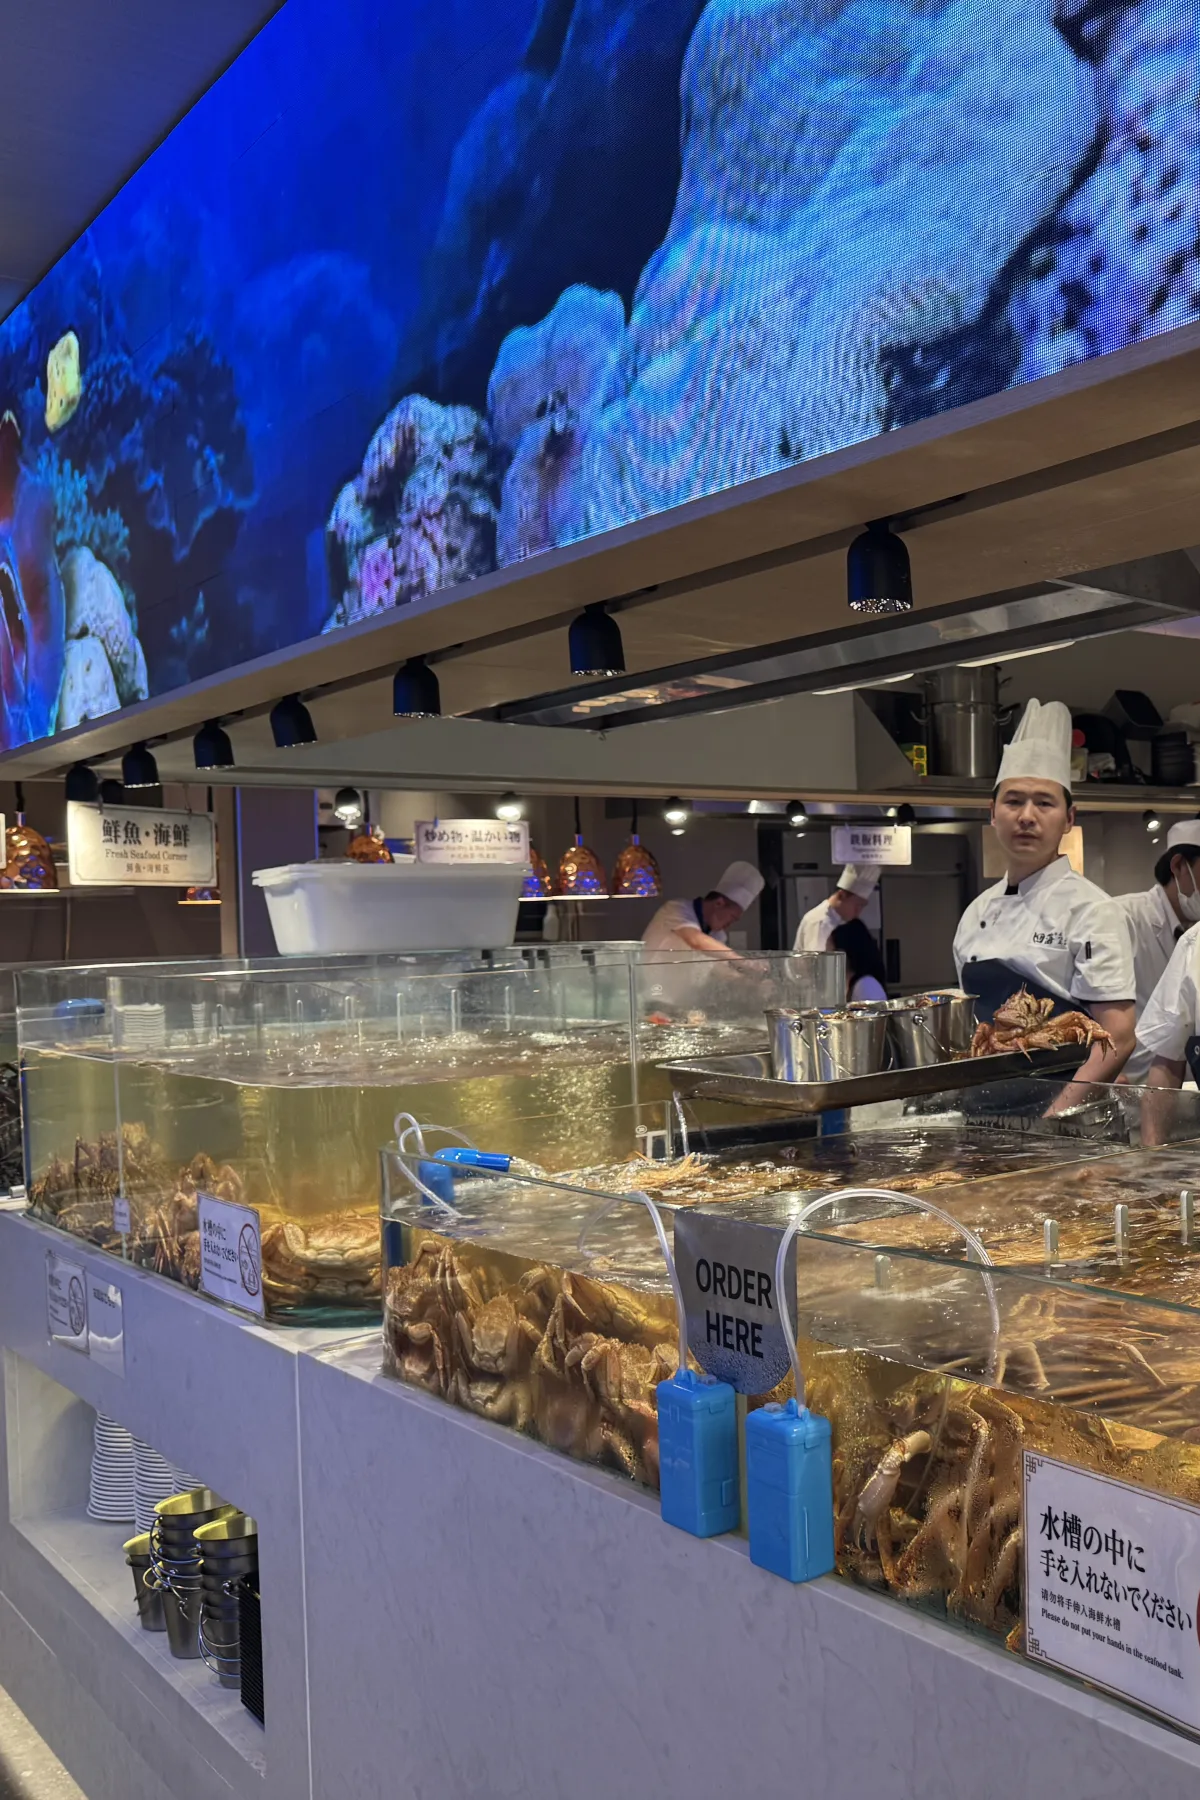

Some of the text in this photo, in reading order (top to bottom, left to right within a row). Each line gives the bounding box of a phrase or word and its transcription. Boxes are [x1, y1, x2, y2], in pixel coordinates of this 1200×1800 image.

[102, 818, 190, 848] 鮮魚・海鮮
[105, 848, 188, 861] Fresh Seafood Corner
[695, 1258, 773, 1310] ORDER
[705, 1309, 764, 1359] HERE
[1039, 1505, 1146, 1574] 水槽の中に
[1039, 1548, 1193, 1632] 手を入れないでください
[1041, 1607, 1184, 1680] Please do not put your hands in the seafood tank.
